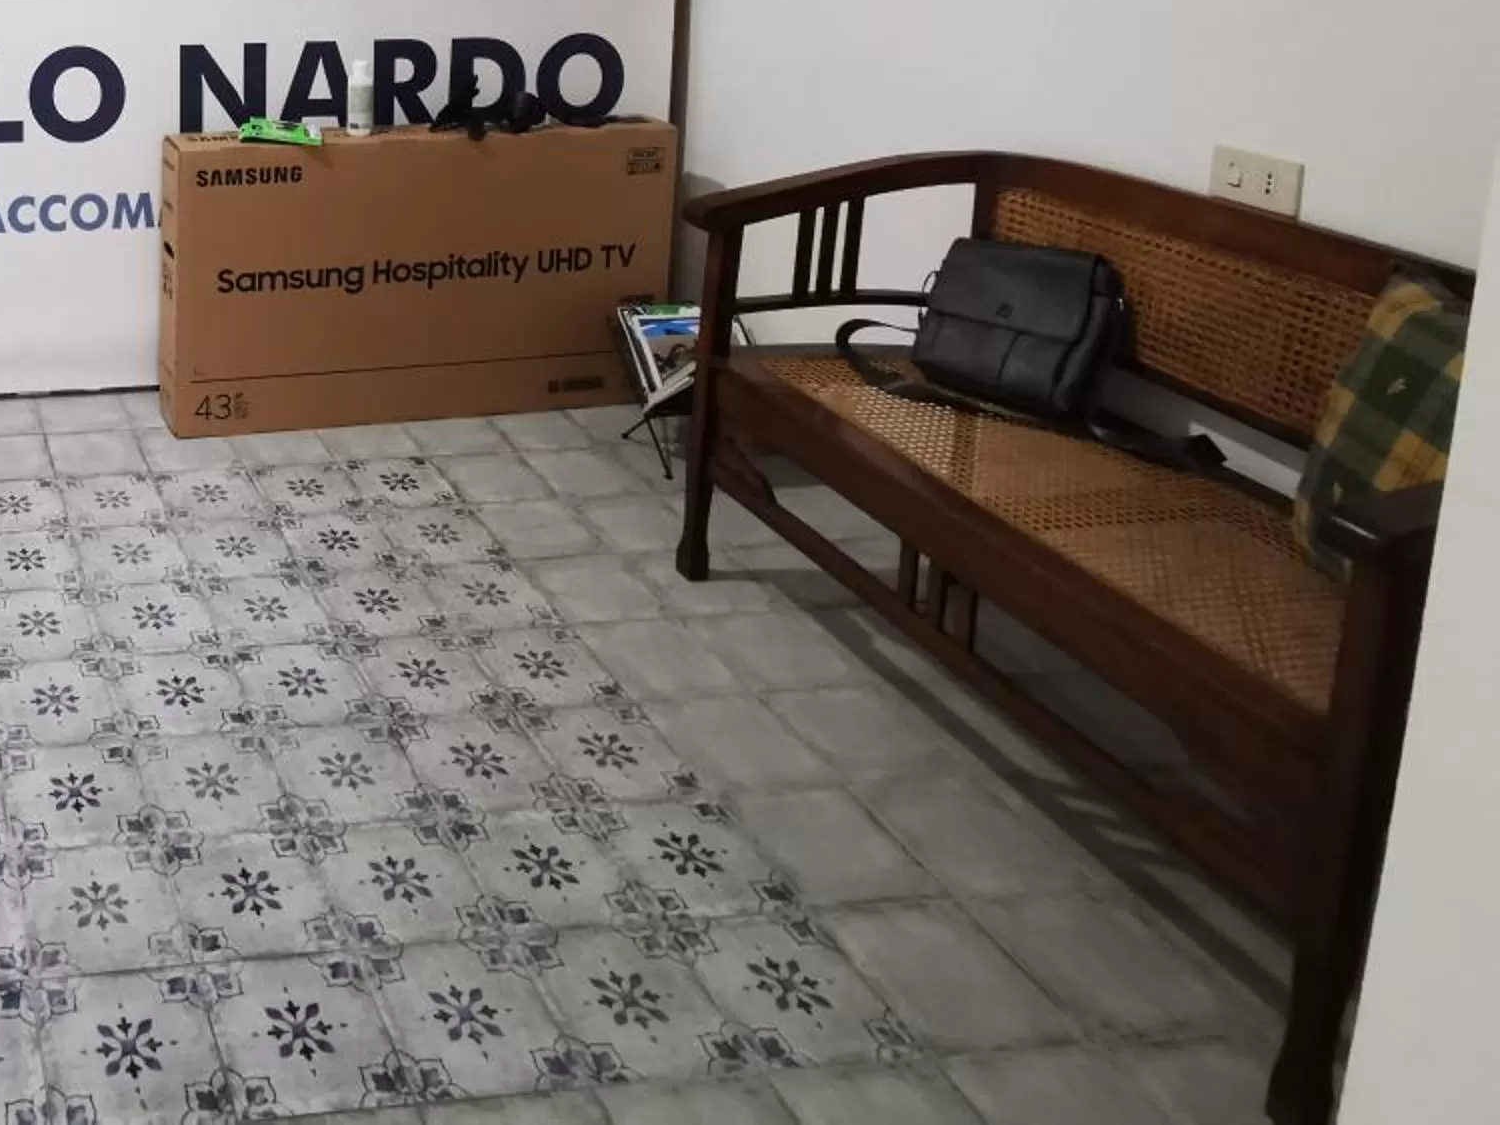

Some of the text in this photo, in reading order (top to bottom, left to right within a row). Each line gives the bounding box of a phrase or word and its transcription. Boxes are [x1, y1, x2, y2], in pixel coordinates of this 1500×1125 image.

[180, 32, 625, 133] NARDO
[196, 166, 303, 187] SAMSUNG
[217, 243, 637, 295] Samsung Hospitality UHD TV
